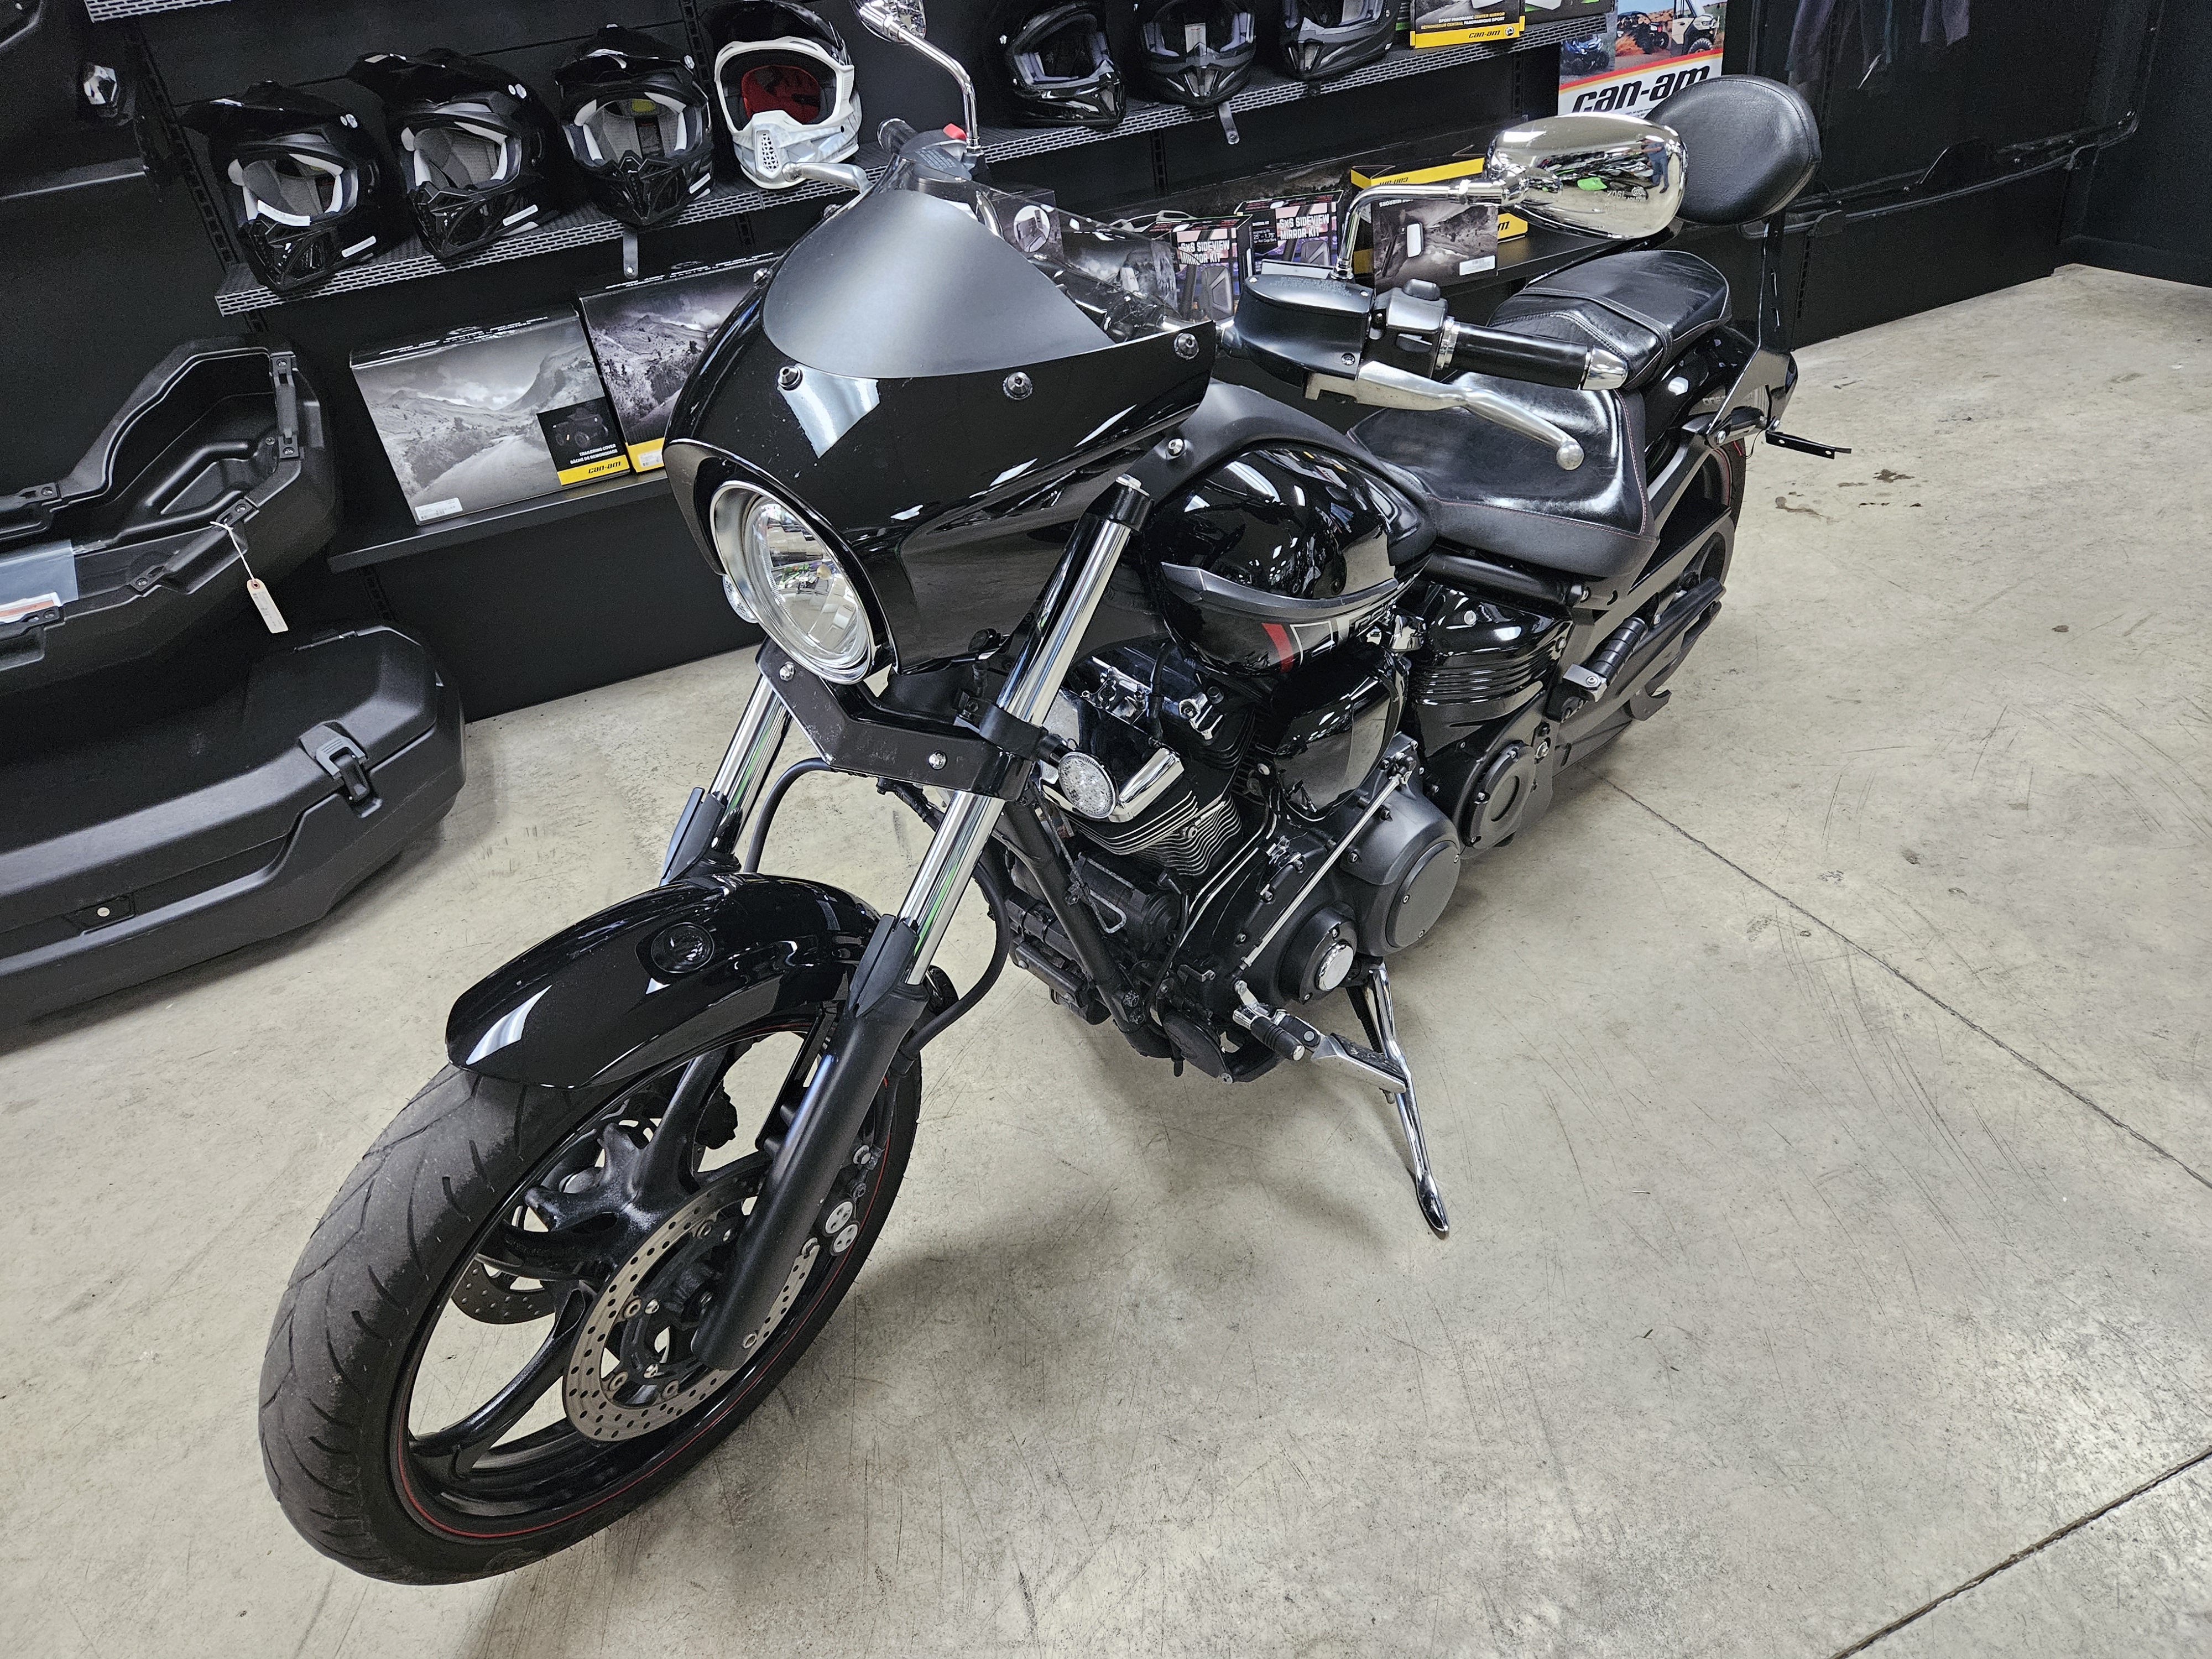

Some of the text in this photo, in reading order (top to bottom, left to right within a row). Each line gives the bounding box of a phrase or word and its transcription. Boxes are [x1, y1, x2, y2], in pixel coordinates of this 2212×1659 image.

[1468, 30, 1501, 39] can-am
[1572, 65, 1710, 113] can-am
[1296, 214, 1330, 227] SIDEVIEW
[1280, 227, 1321, 241] MIRROR KIT
[1197, 240, 1230, 252] SIDEVIEW
[1180, 252, 1208, 265] MIRROR
[1209, 252, 1222, 263] KIT
[588, 461, 620, 474] can-am
